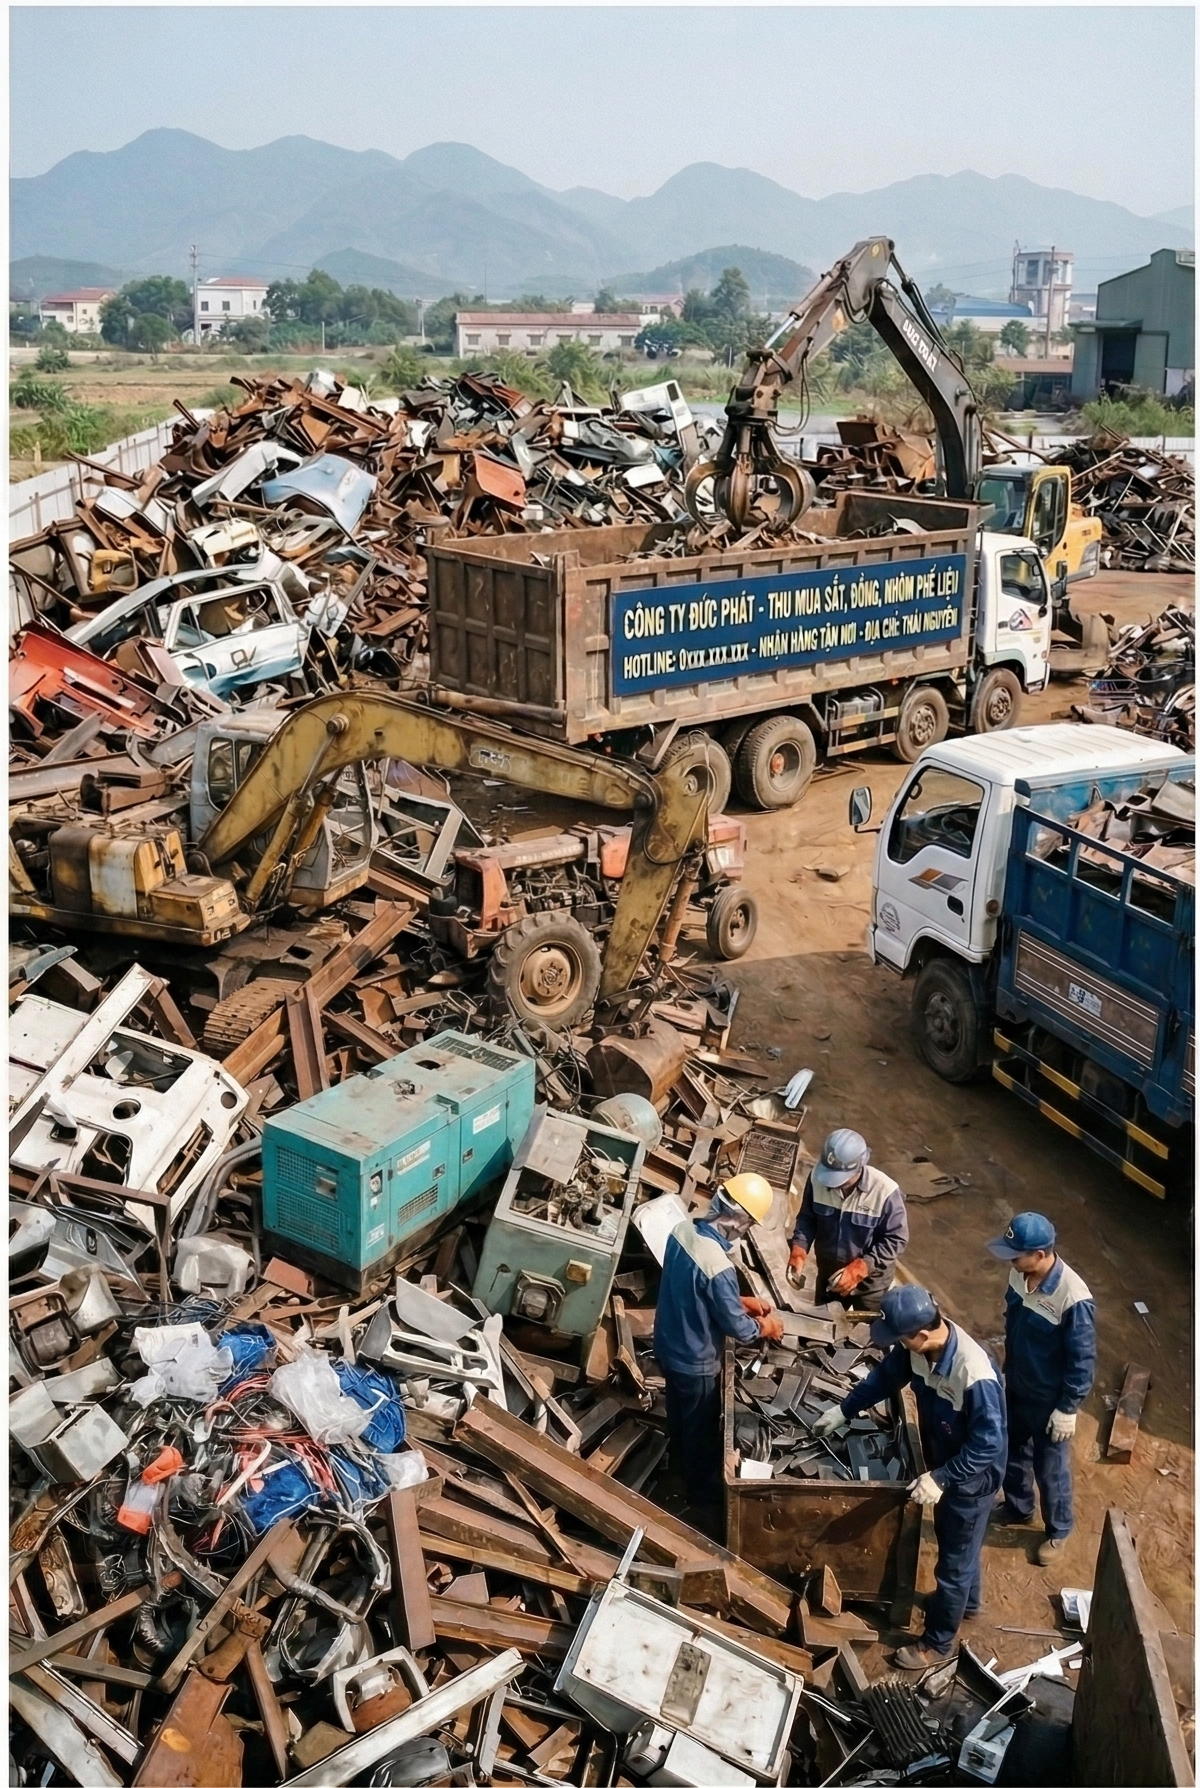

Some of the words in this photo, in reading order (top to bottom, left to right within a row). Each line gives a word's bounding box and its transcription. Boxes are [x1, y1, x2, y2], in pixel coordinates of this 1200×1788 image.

[624, 601, 665, 640] CÔNG
[669, 602, 686, 633] TY
[688, 592, 718, 631] ĐỨC
[721, 590, 755, 627] PHÁT
[768, 590, 792, 620] THU
[795, 587, 821, 616] MUA
[824, 573, 848, 613] SẮT,
[884, 571, 915, 604] NHÔM
[916, 563, 937, 599] PHẾ
[624, 649, 676, 679] HOTLINE:
[759, 629, 789, 660] NHẬN
[790, 625, 819, 654] HÀNG
[820, 622, 839, 652] TẬN
[902, 608, 922, 635] THÁI
